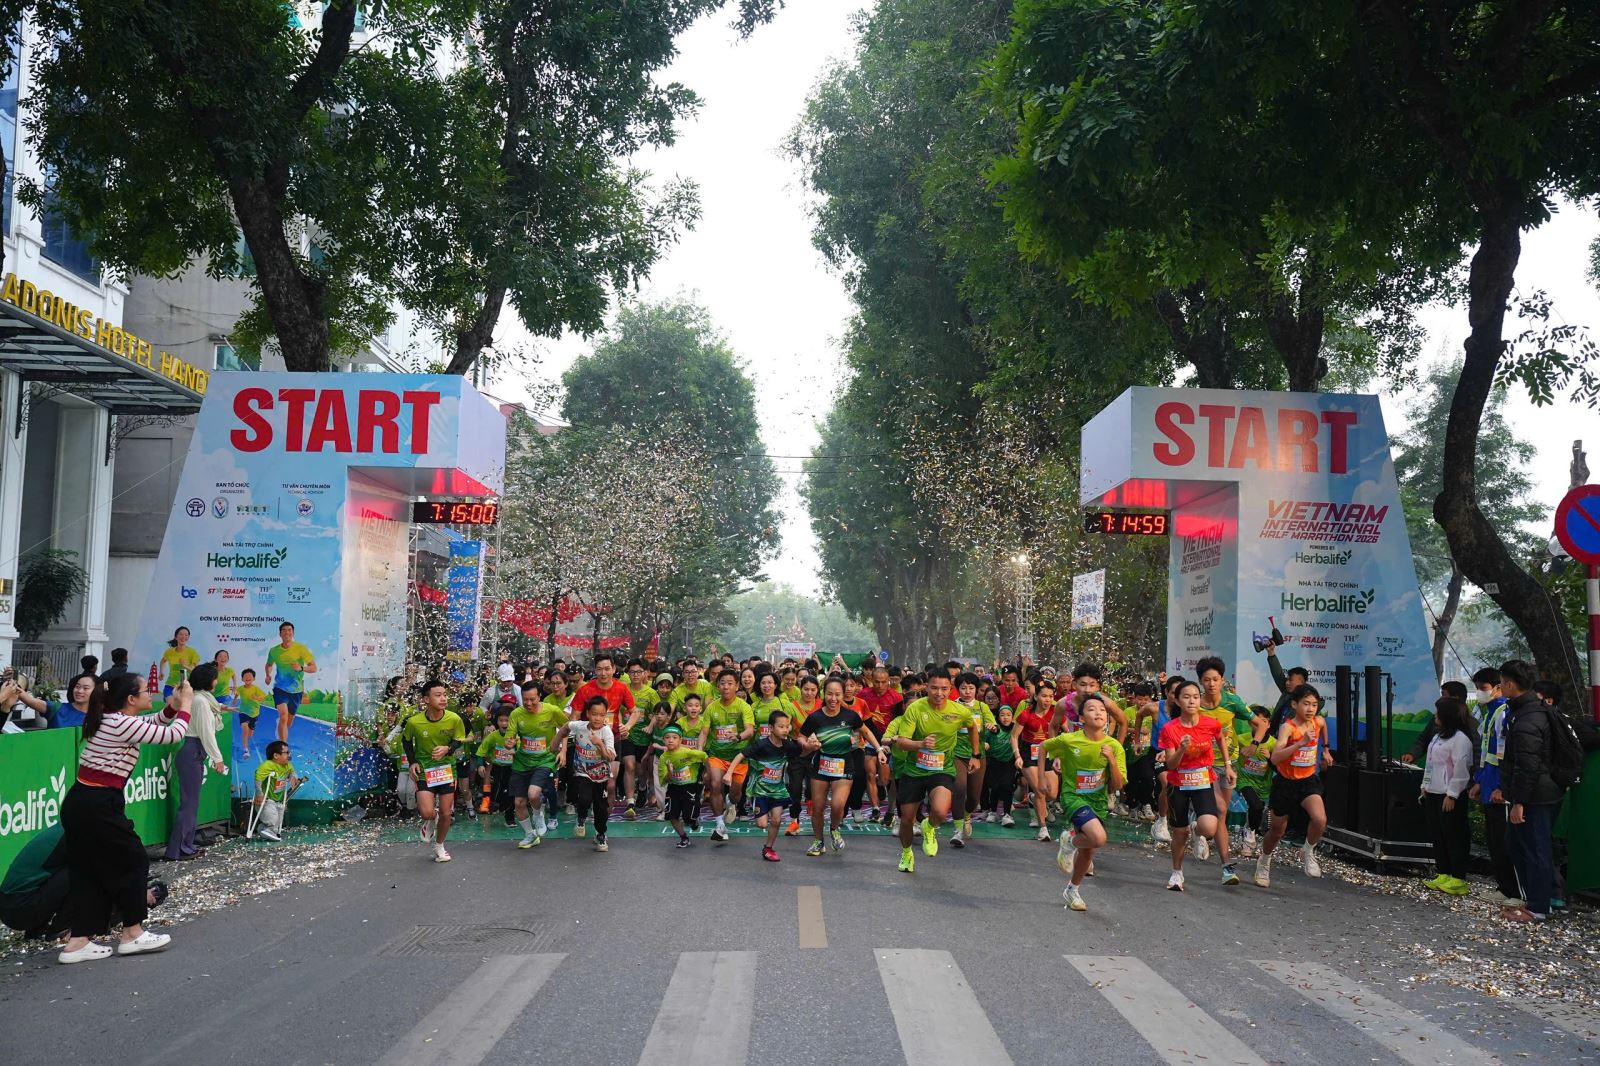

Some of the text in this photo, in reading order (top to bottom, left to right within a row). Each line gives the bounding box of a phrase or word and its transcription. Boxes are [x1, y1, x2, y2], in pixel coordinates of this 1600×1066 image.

[1, 272, 209, 396] ADONIS HOTEL HANO
[230, 387, 440, 454] START
[1153, 401, 1357, 474] START
[1268, 500, 1389, 524] VIETNAM
[1183, 522, 1225, 551] VIETNAM
[1260, 530, 1380, 544] HALF MARATHON 2026
[1263, 519, 1381, 535] INTERNATIONAL
[207, 552, 280, 568] Herbalife
[1296, 552, 1347, 565] Herbalife
[181, 586, 197, 599] be
[1281, 592, 1367, 614] Herbalife
[1184, 618, 1210, 637] Herbalife
[1343, 642, 1363, 650] true
[125, 767, 168, 804] balife
[0, 787, 58, 836] balife
